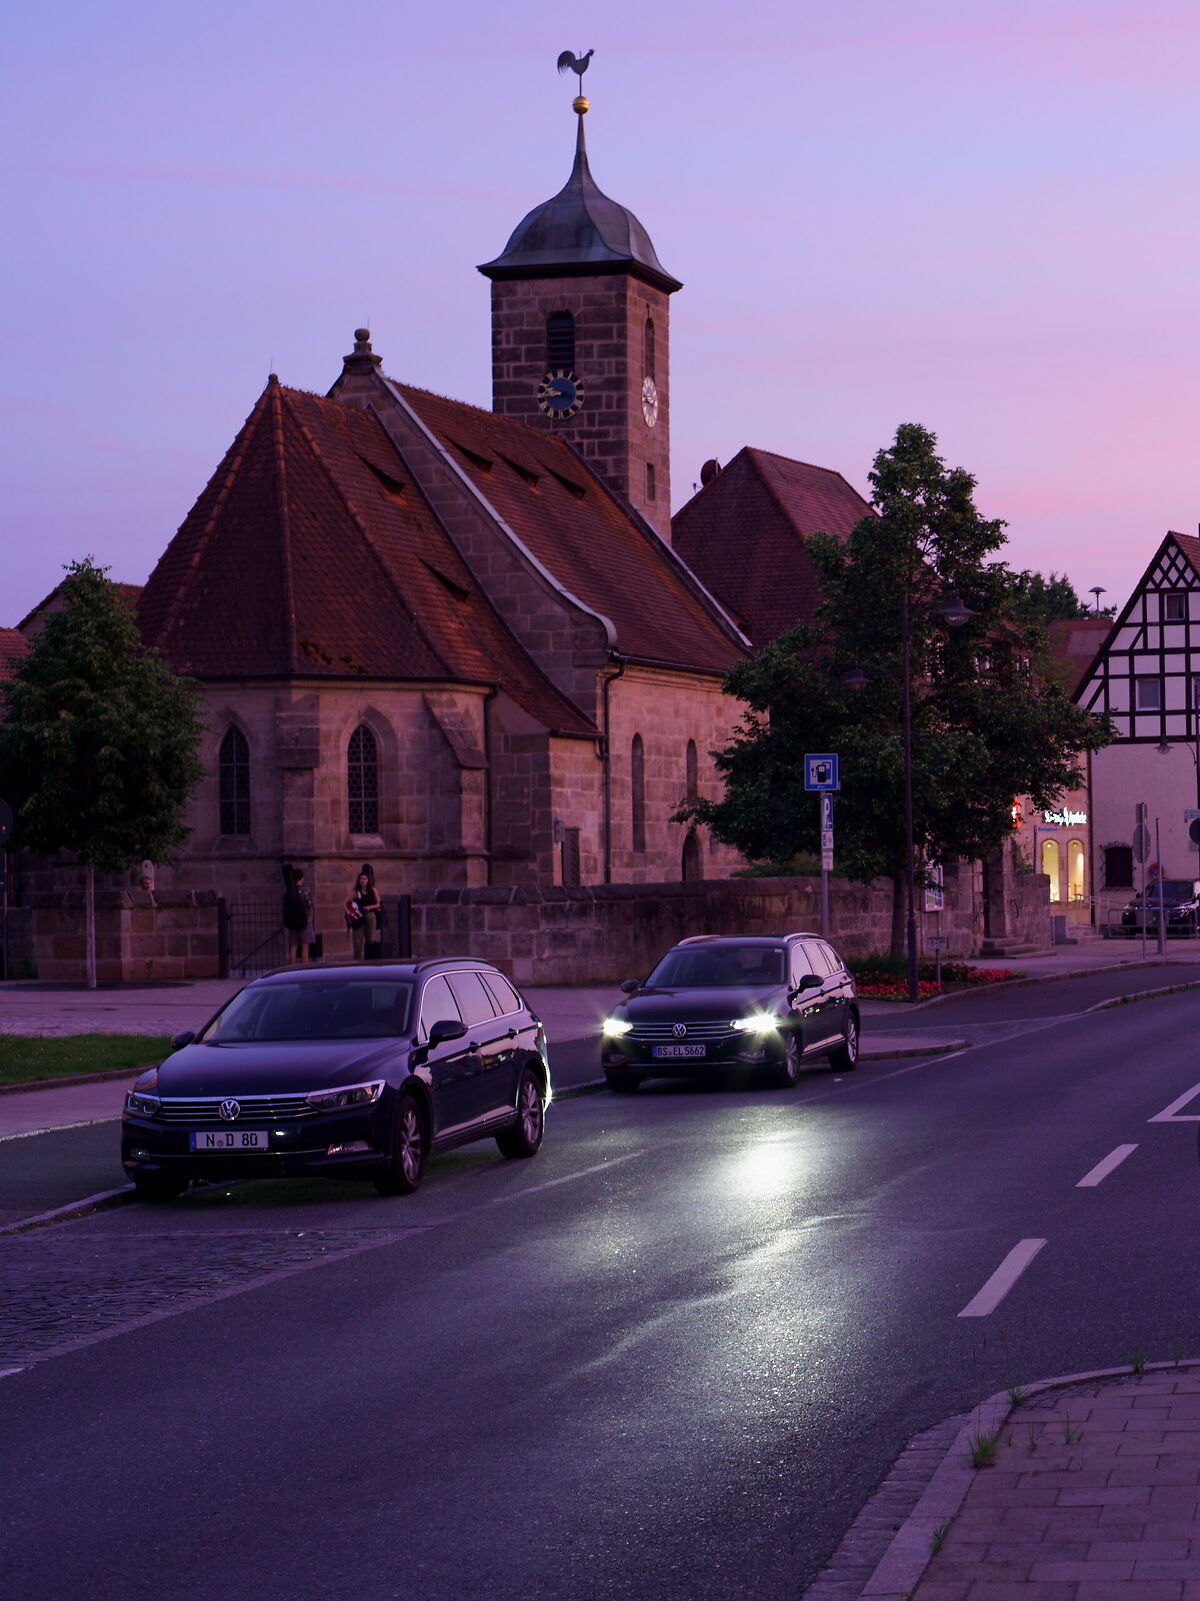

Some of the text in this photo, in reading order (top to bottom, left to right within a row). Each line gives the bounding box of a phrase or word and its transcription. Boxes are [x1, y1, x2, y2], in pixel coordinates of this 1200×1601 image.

[657, 1047, 668, 1057] BS
[206, 1133, 258, 1147] N D 80
